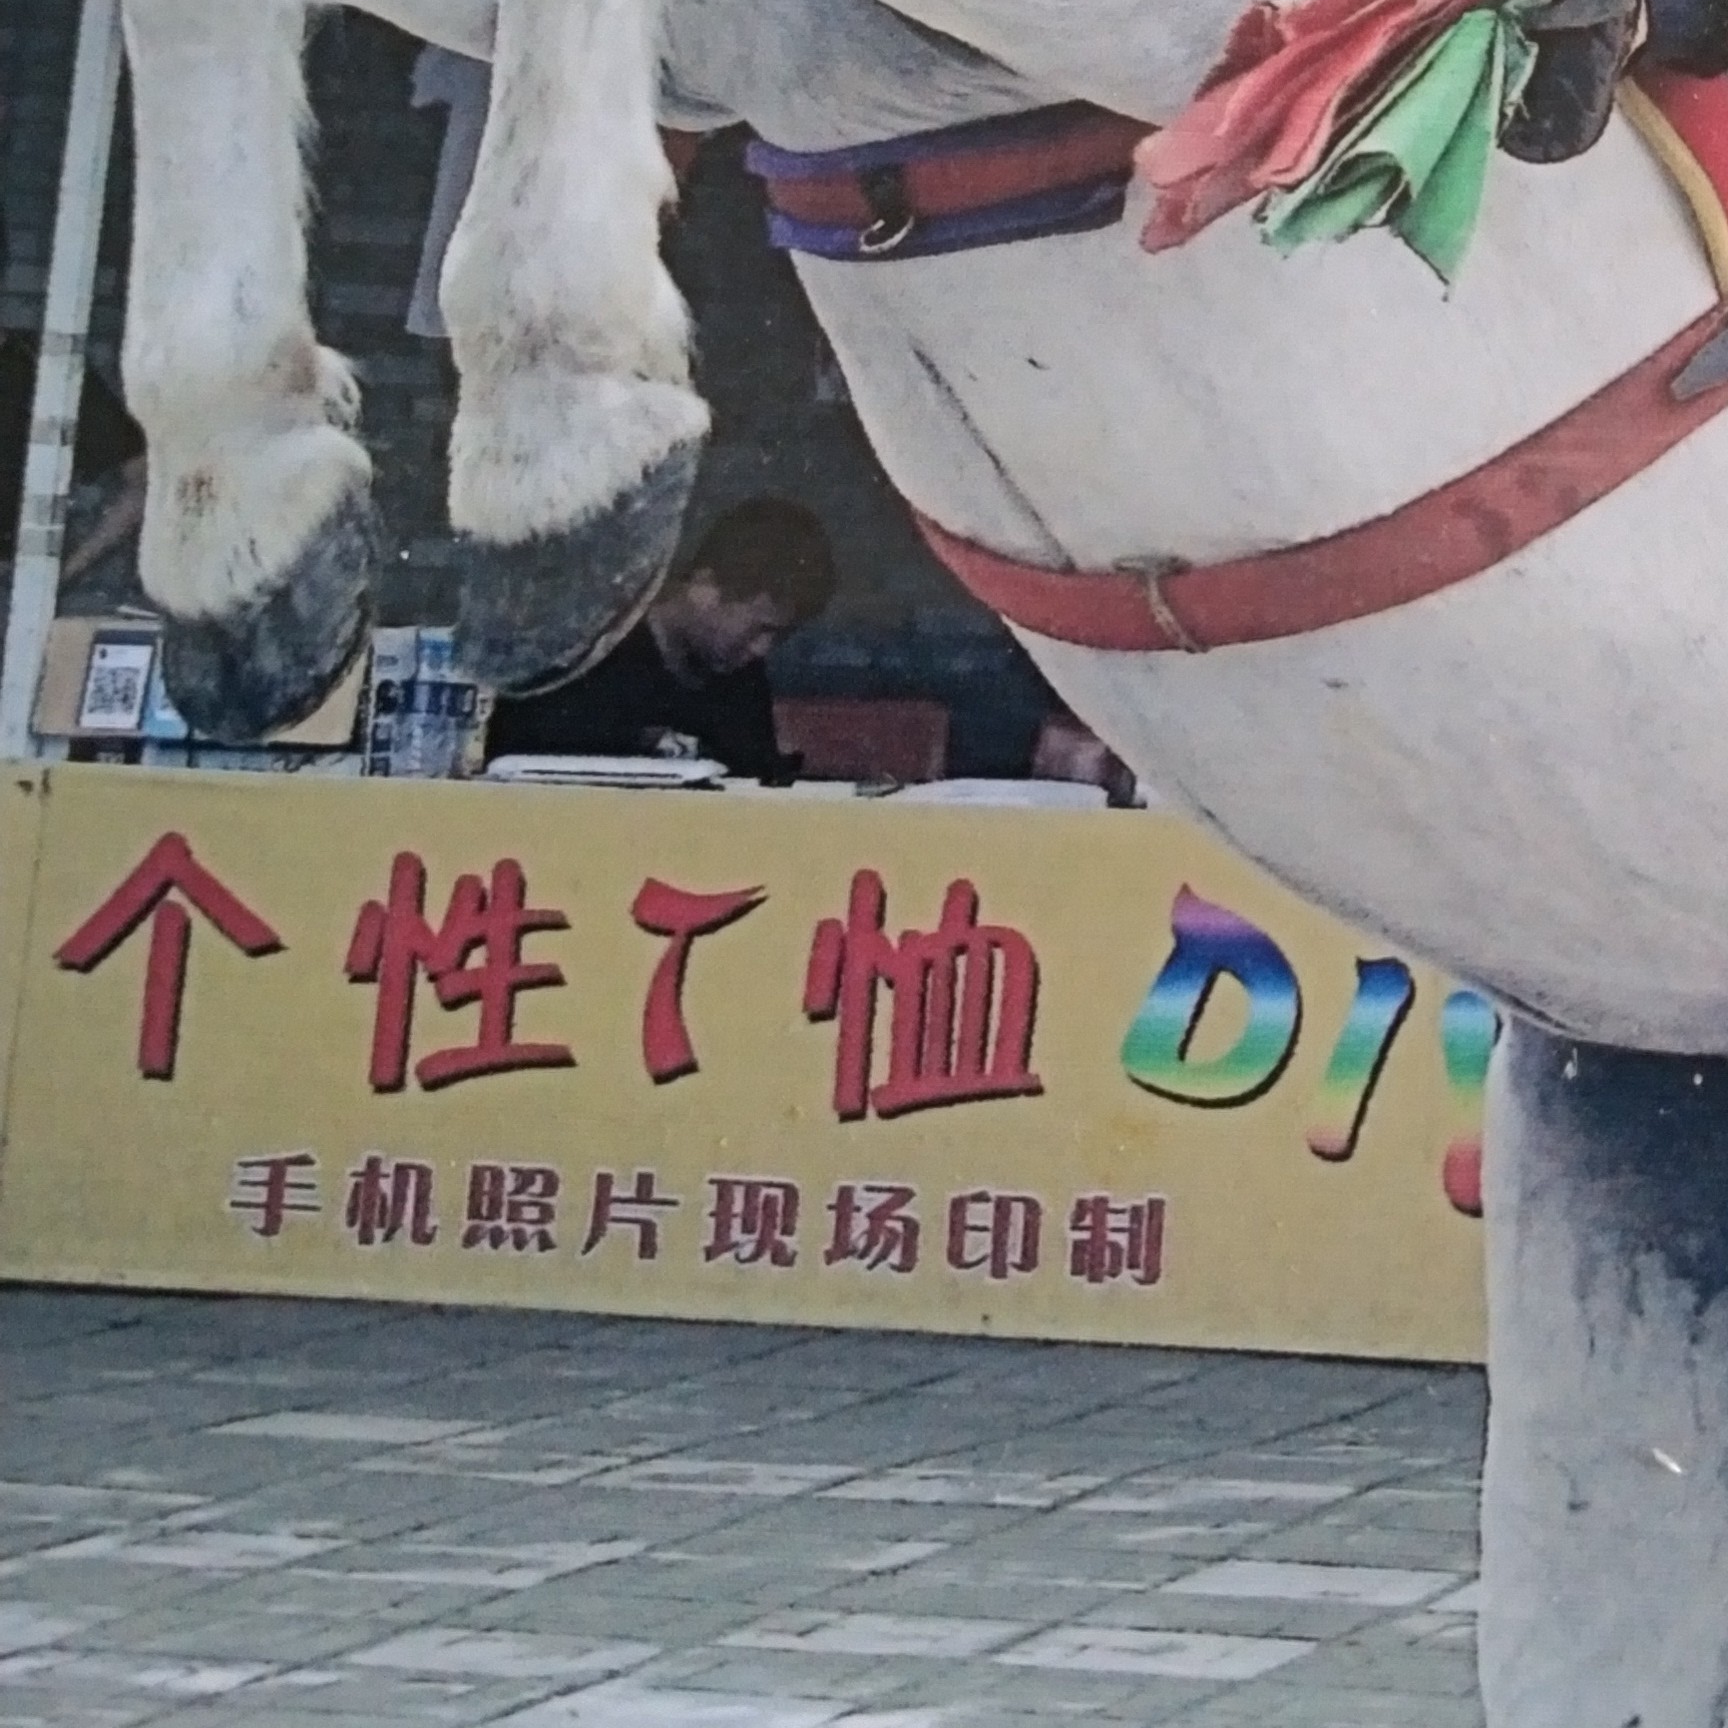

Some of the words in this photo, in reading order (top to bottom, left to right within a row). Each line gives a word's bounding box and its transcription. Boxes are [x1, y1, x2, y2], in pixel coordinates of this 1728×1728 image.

[54, 830, 1044, 1122] 个性T恤
[229, 1152, 1167, 1285] 手机照片现场印制
